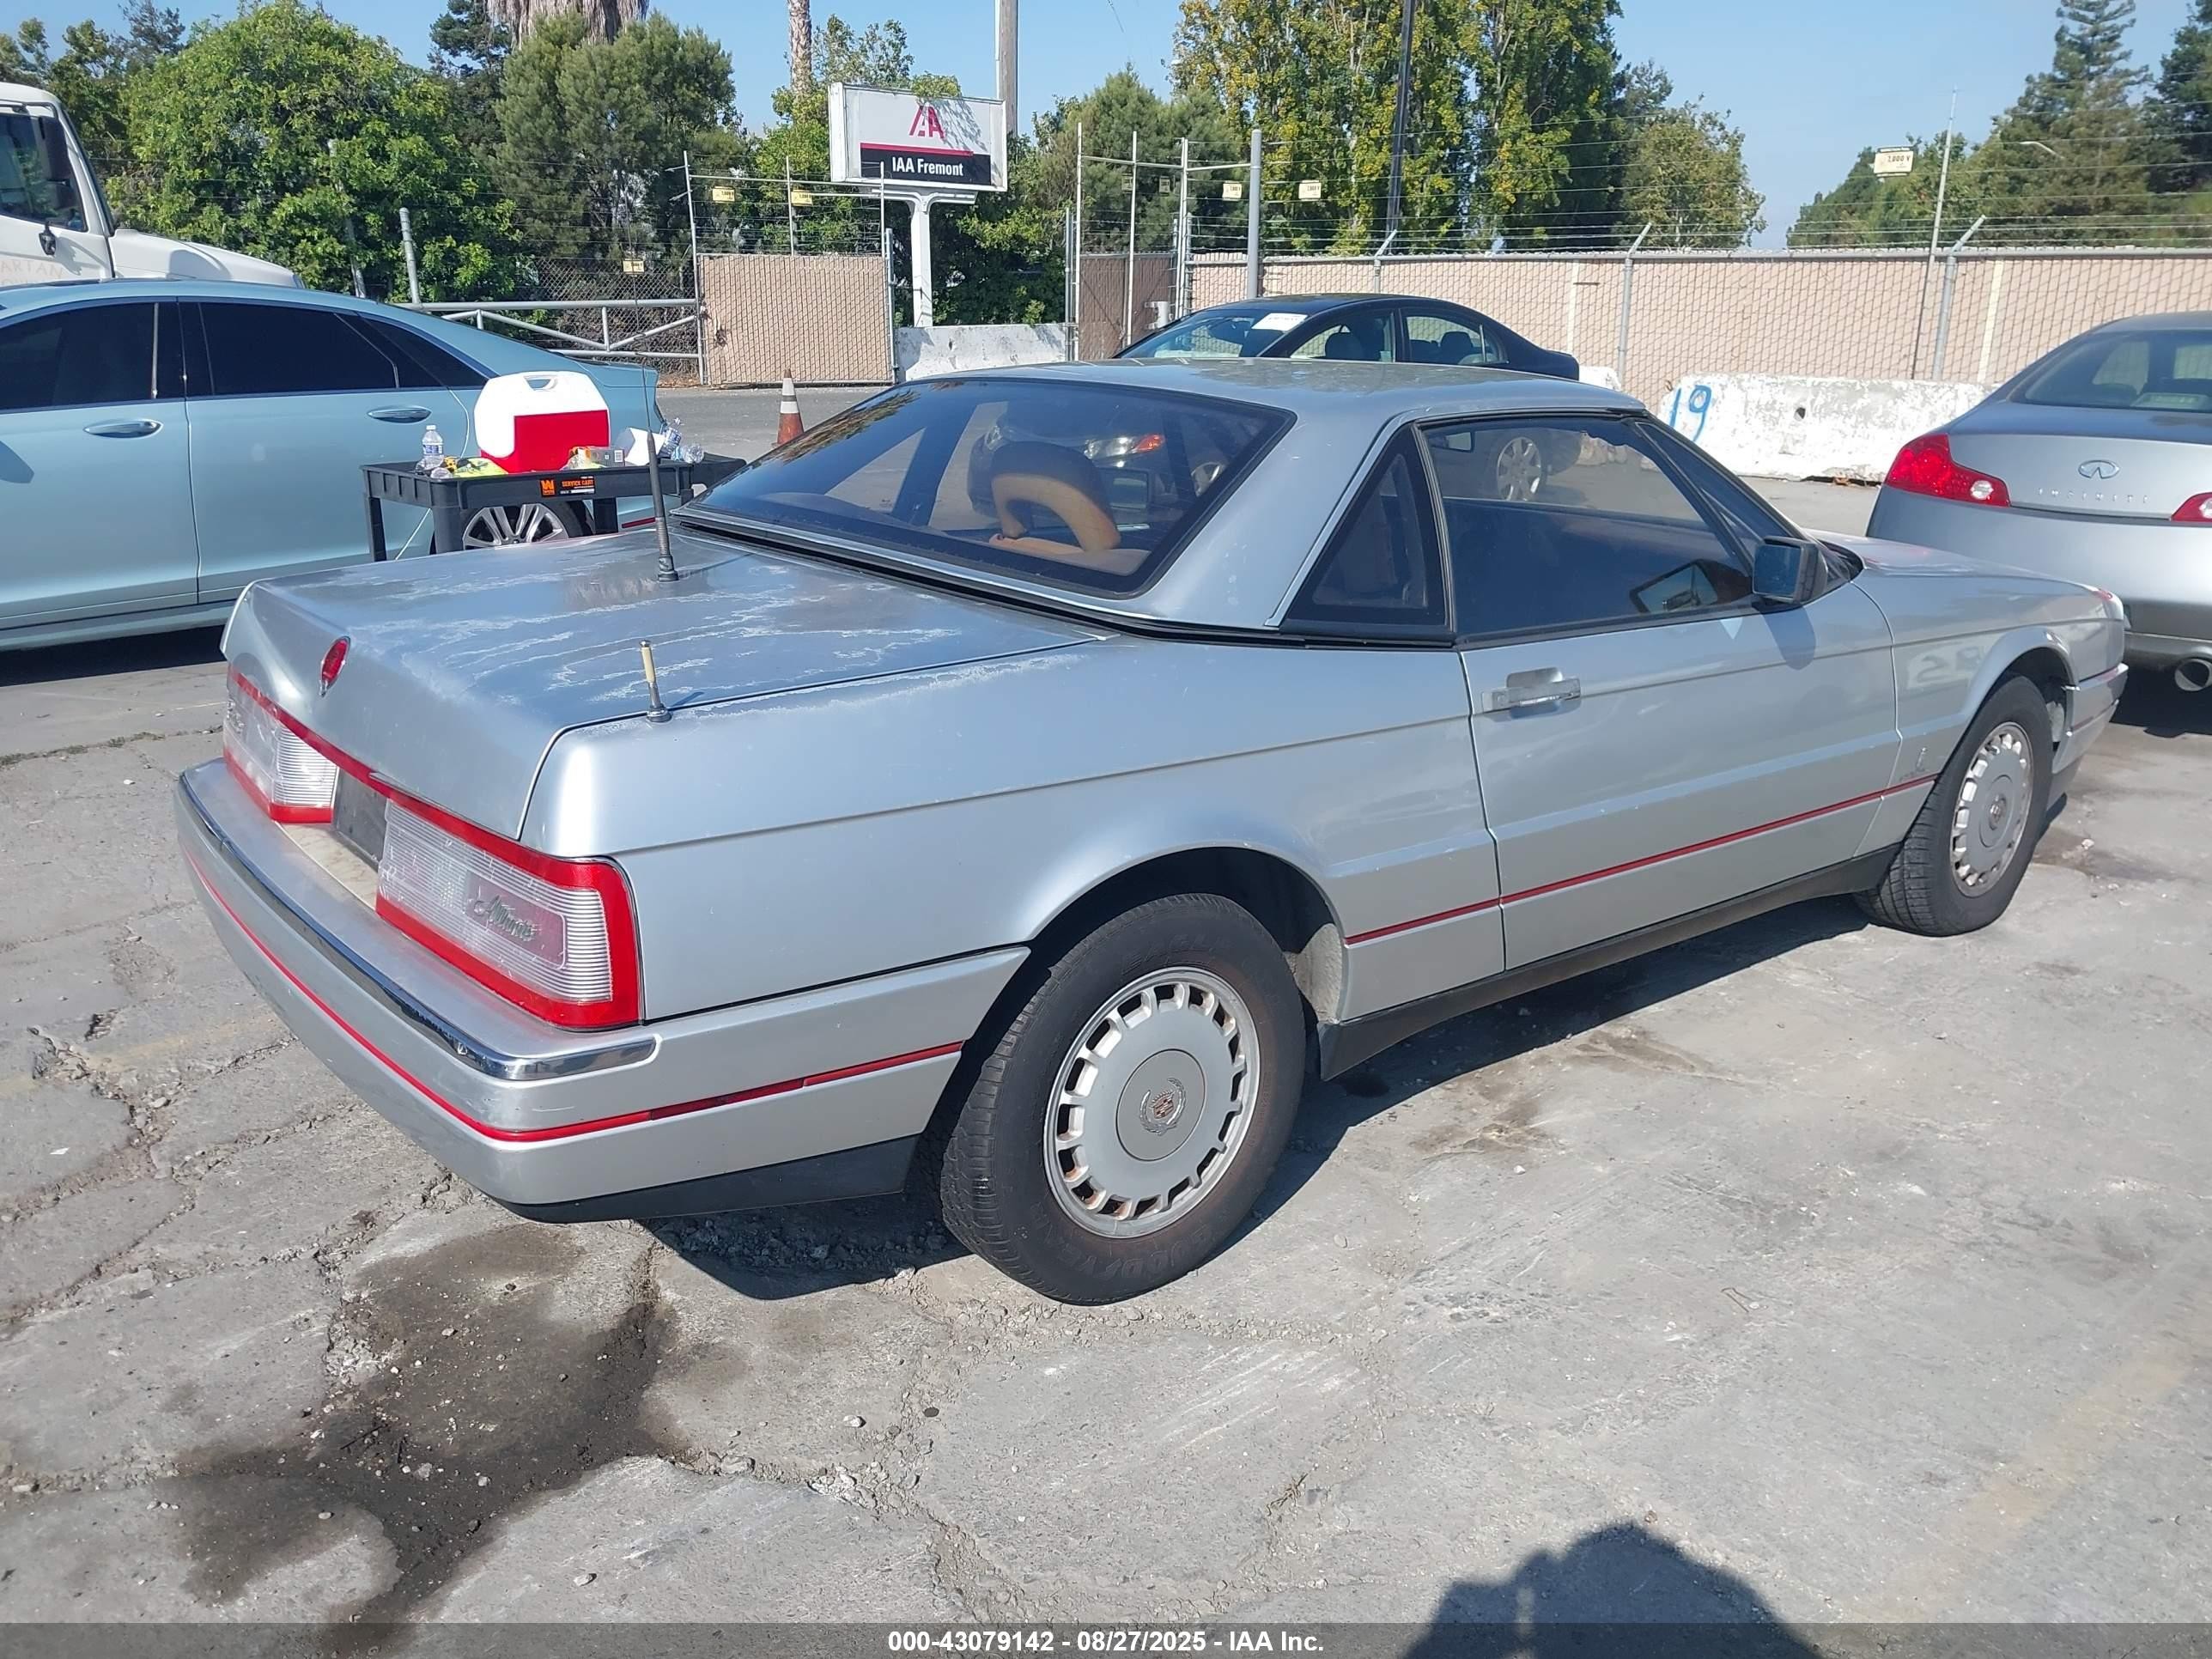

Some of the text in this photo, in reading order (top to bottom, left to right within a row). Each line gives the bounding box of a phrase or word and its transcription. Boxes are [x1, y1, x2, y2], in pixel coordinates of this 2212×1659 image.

[892, 156, 963, 176] IAA Fremont
[1669, 384, 1712, 441] 19
